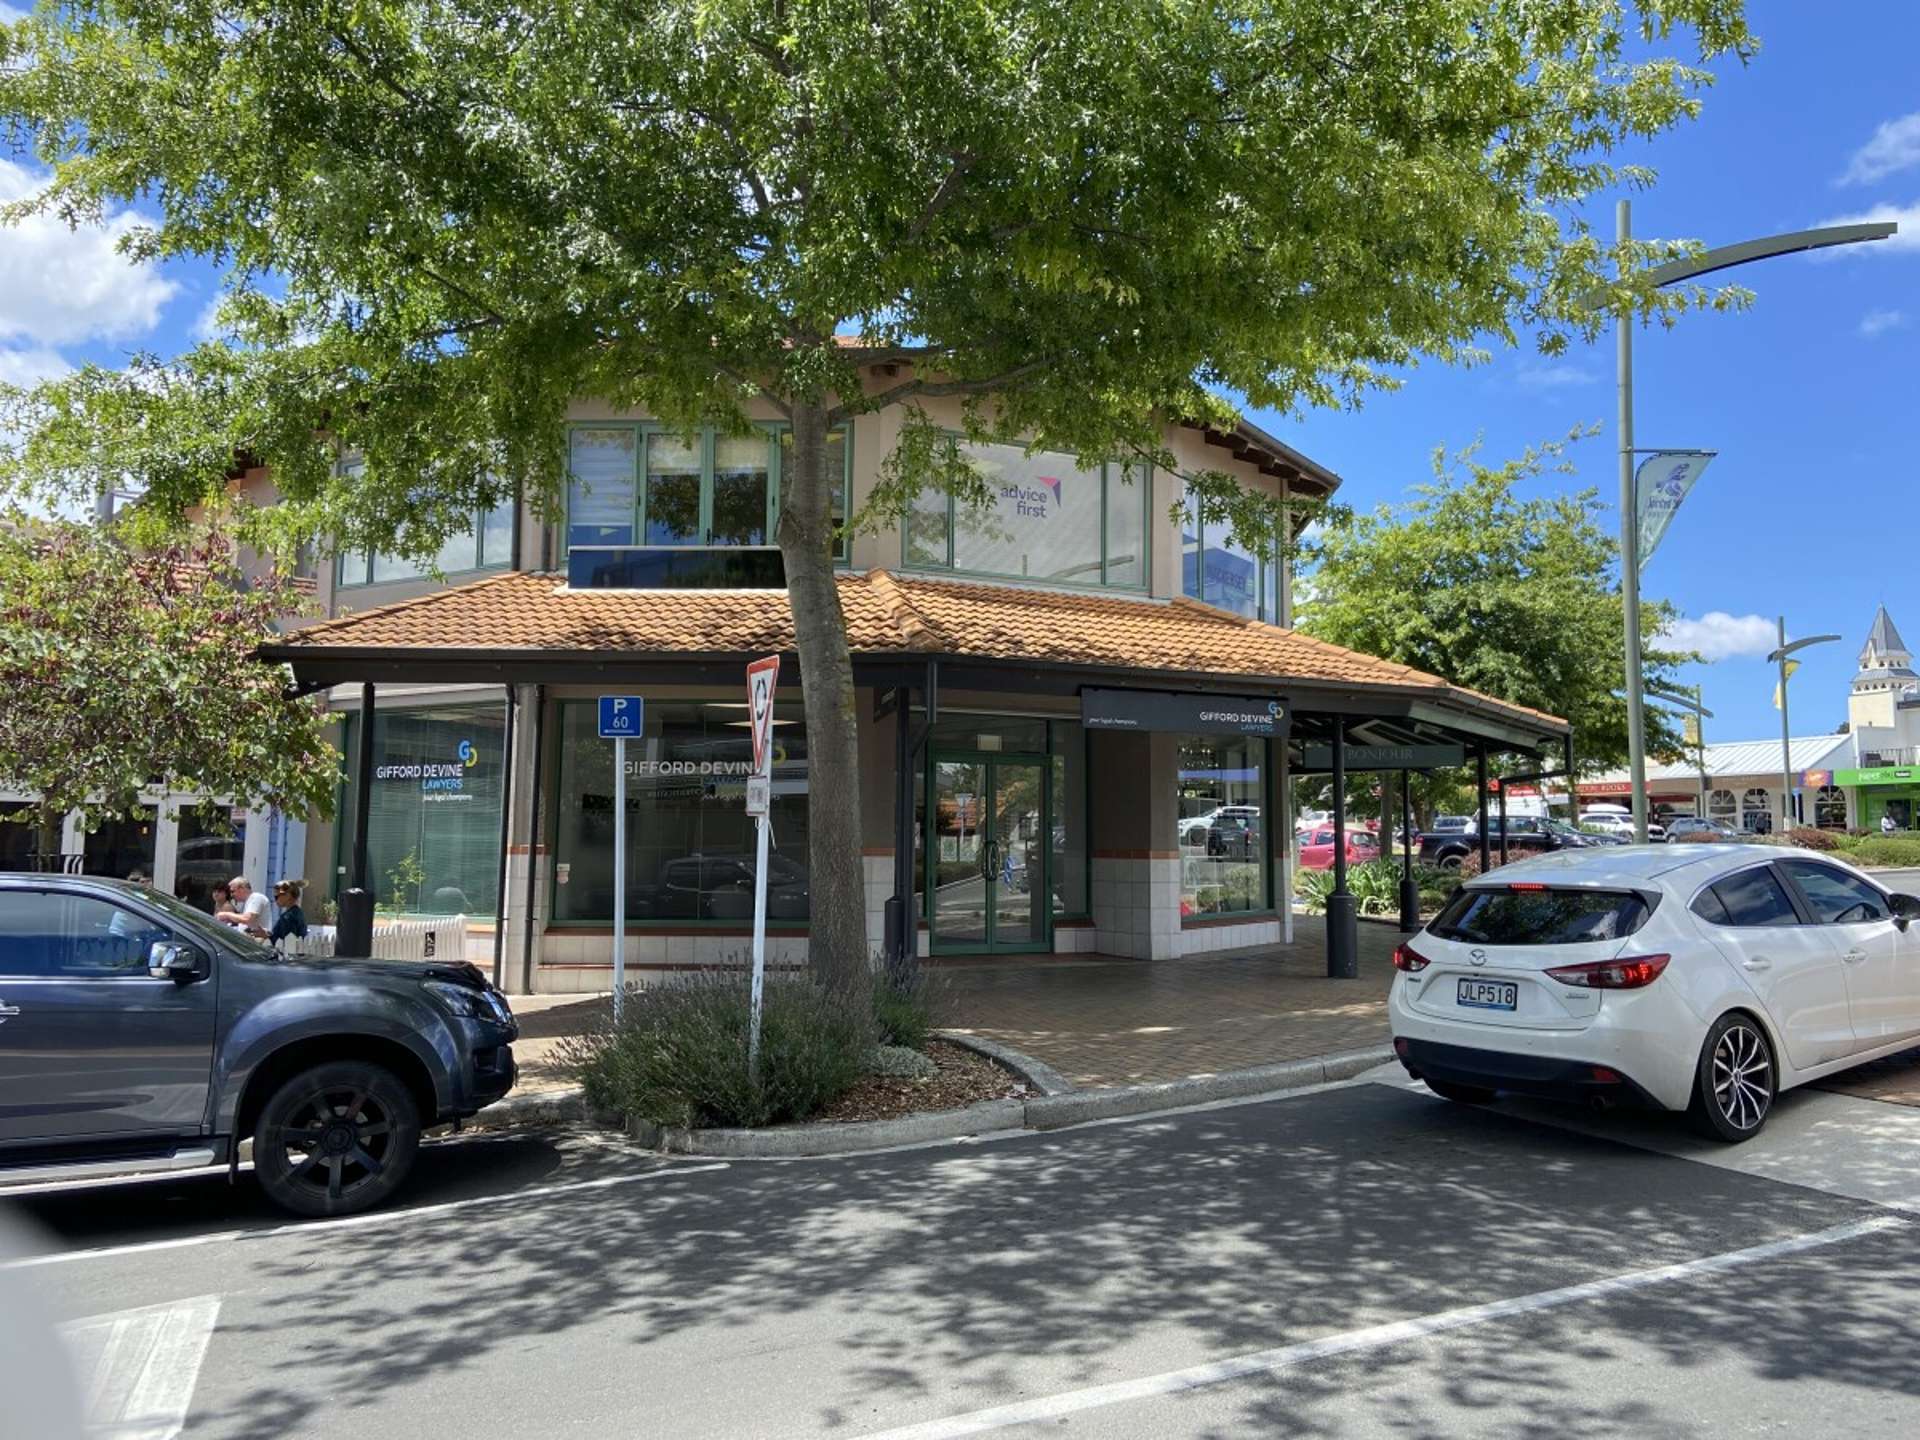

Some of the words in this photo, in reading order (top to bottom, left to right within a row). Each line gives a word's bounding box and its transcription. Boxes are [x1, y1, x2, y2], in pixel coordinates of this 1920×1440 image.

[1000, 484, 1047, 503] advice
[1016, 500, 1047, 518] first
[613, 698, 628, 714] P
[612, 716, 629, 729] 60
[1199, 711, 1240, 722] GIFFORD
[1240, 713, 1273, 724] DEVINE
[1347, 748, 1414, 761] BONJOUR
[376, 765, 421, 778] GIFFORD
[423, 764, 463, 777] DEVINE
[623, 761, 697, 774] GIFFORD
[422, 778, 463, 790] LAWYERS
[1460, 981, 1514, 1004] JLP518
